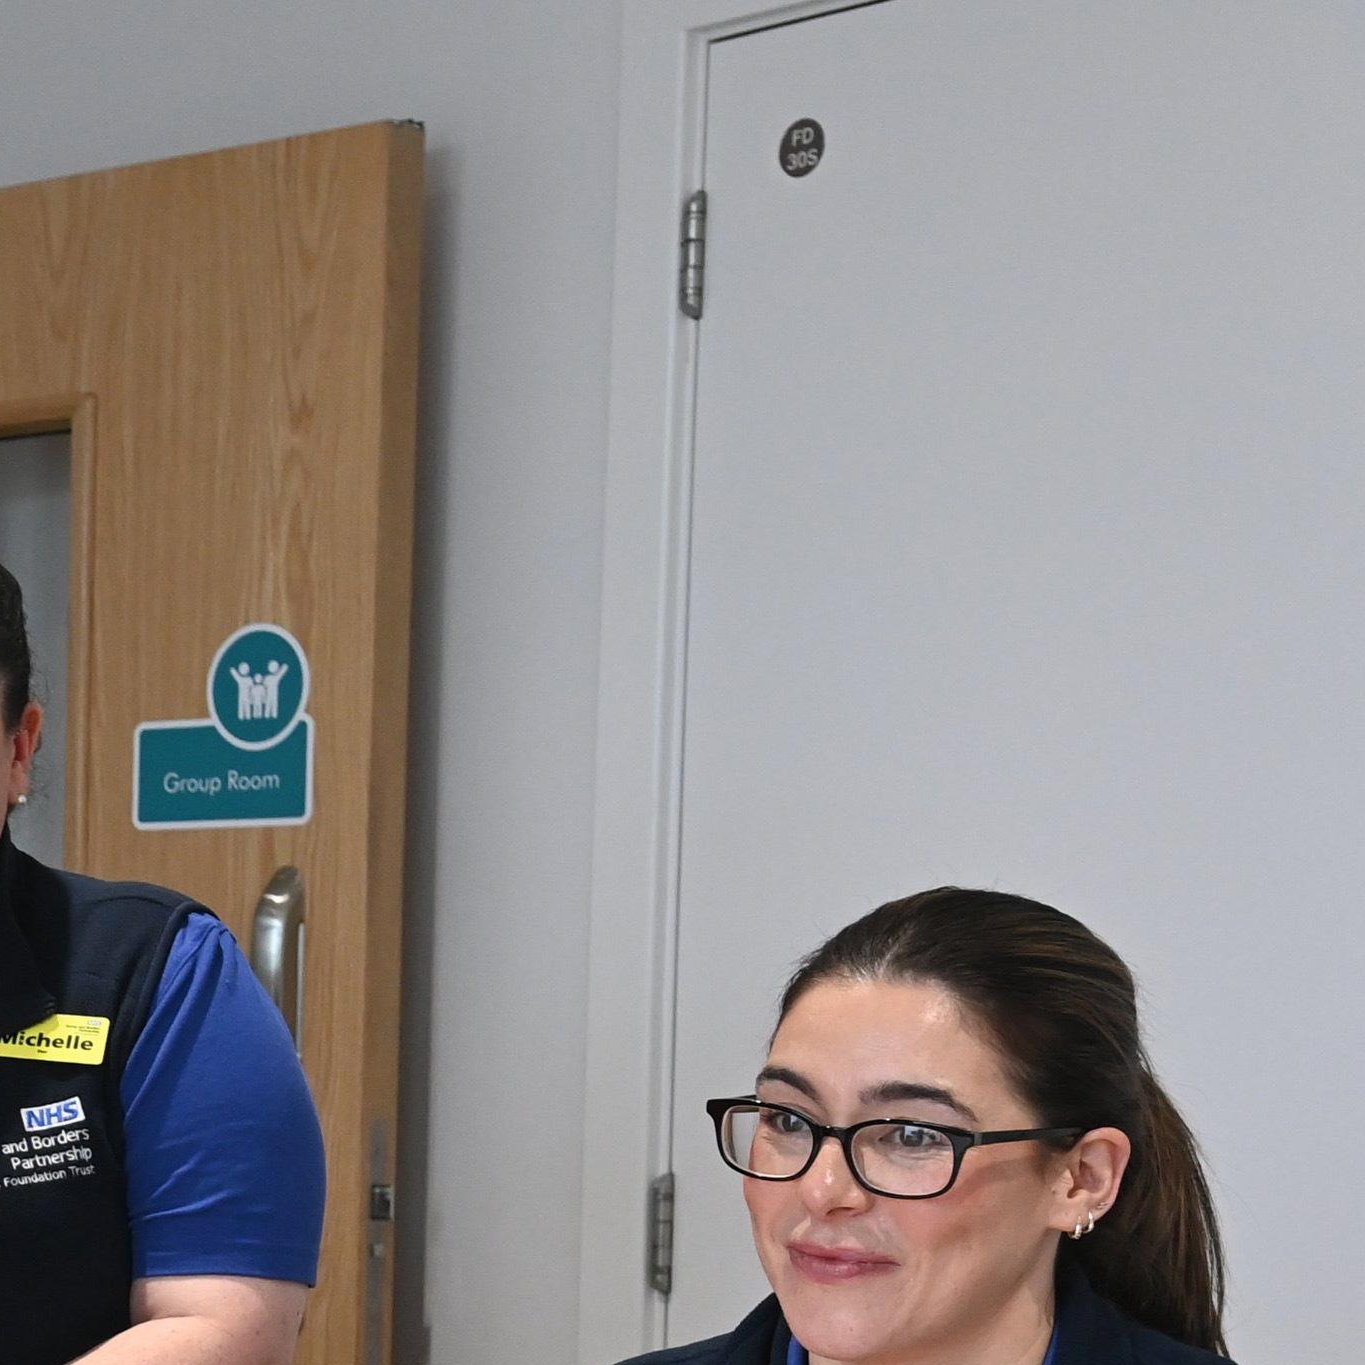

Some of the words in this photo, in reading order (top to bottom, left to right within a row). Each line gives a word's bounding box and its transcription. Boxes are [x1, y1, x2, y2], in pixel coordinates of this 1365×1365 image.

[792, 127, 814, 147] FD
[164, 771, 222, 796] Group
[227, 769, 280, 790] Room
[25, 1101, 80, 1128] NHS
[1, 1138, 29, 1154] and
[31, 1128, 90, 1150] Borders
[10, 1145, 92, 1170] Partnership
[3, 1169, 67, 1188] Foundation
[69, 1164, 95, 1177] Trust
